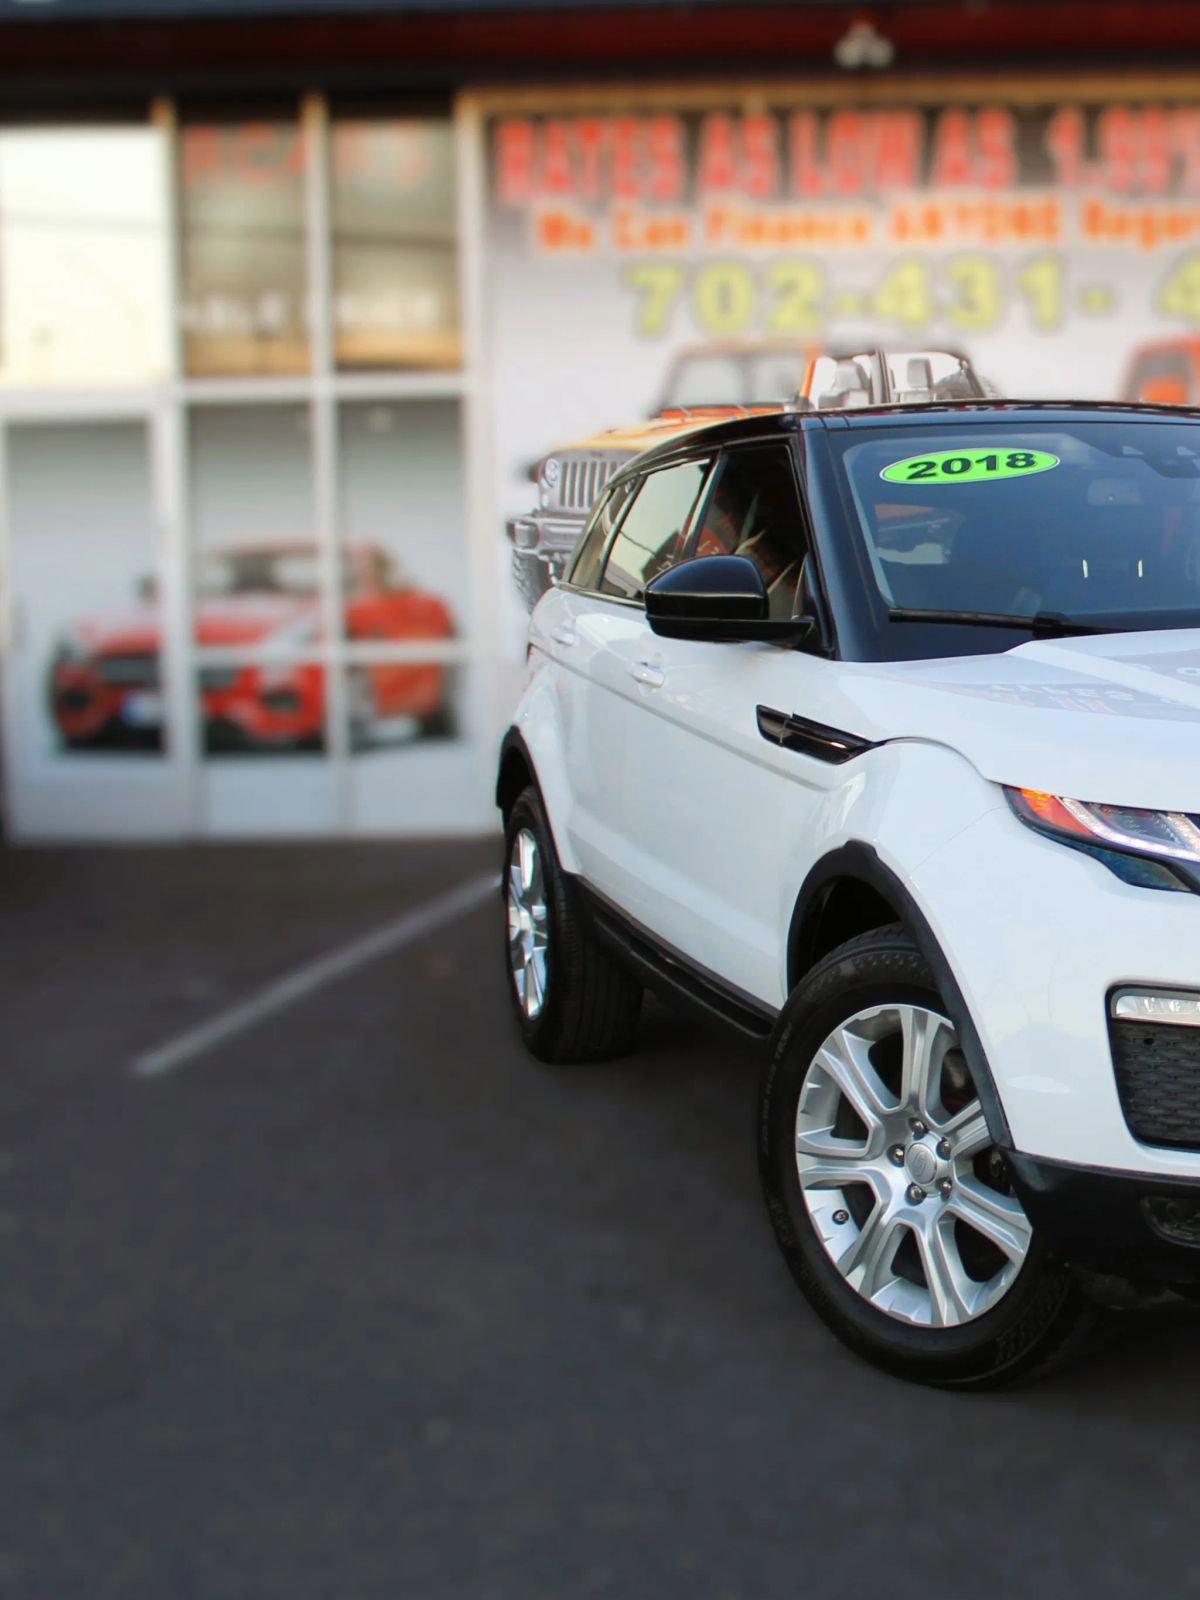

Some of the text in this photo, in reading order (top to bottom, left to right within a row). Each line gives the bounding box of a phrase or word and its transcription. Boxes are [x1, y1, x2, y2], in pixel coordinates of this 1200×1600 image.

[496, 115, 684, 200] RATES
[701, 112, 777, 196] AS
[793, 109, 920, 194] LOW
[935, 108, 1016, 190] AS
[612, 207, 689, 250] Can
[706, 206, 870, 246] Finance
[907, 453, 1037, 480] 2018
